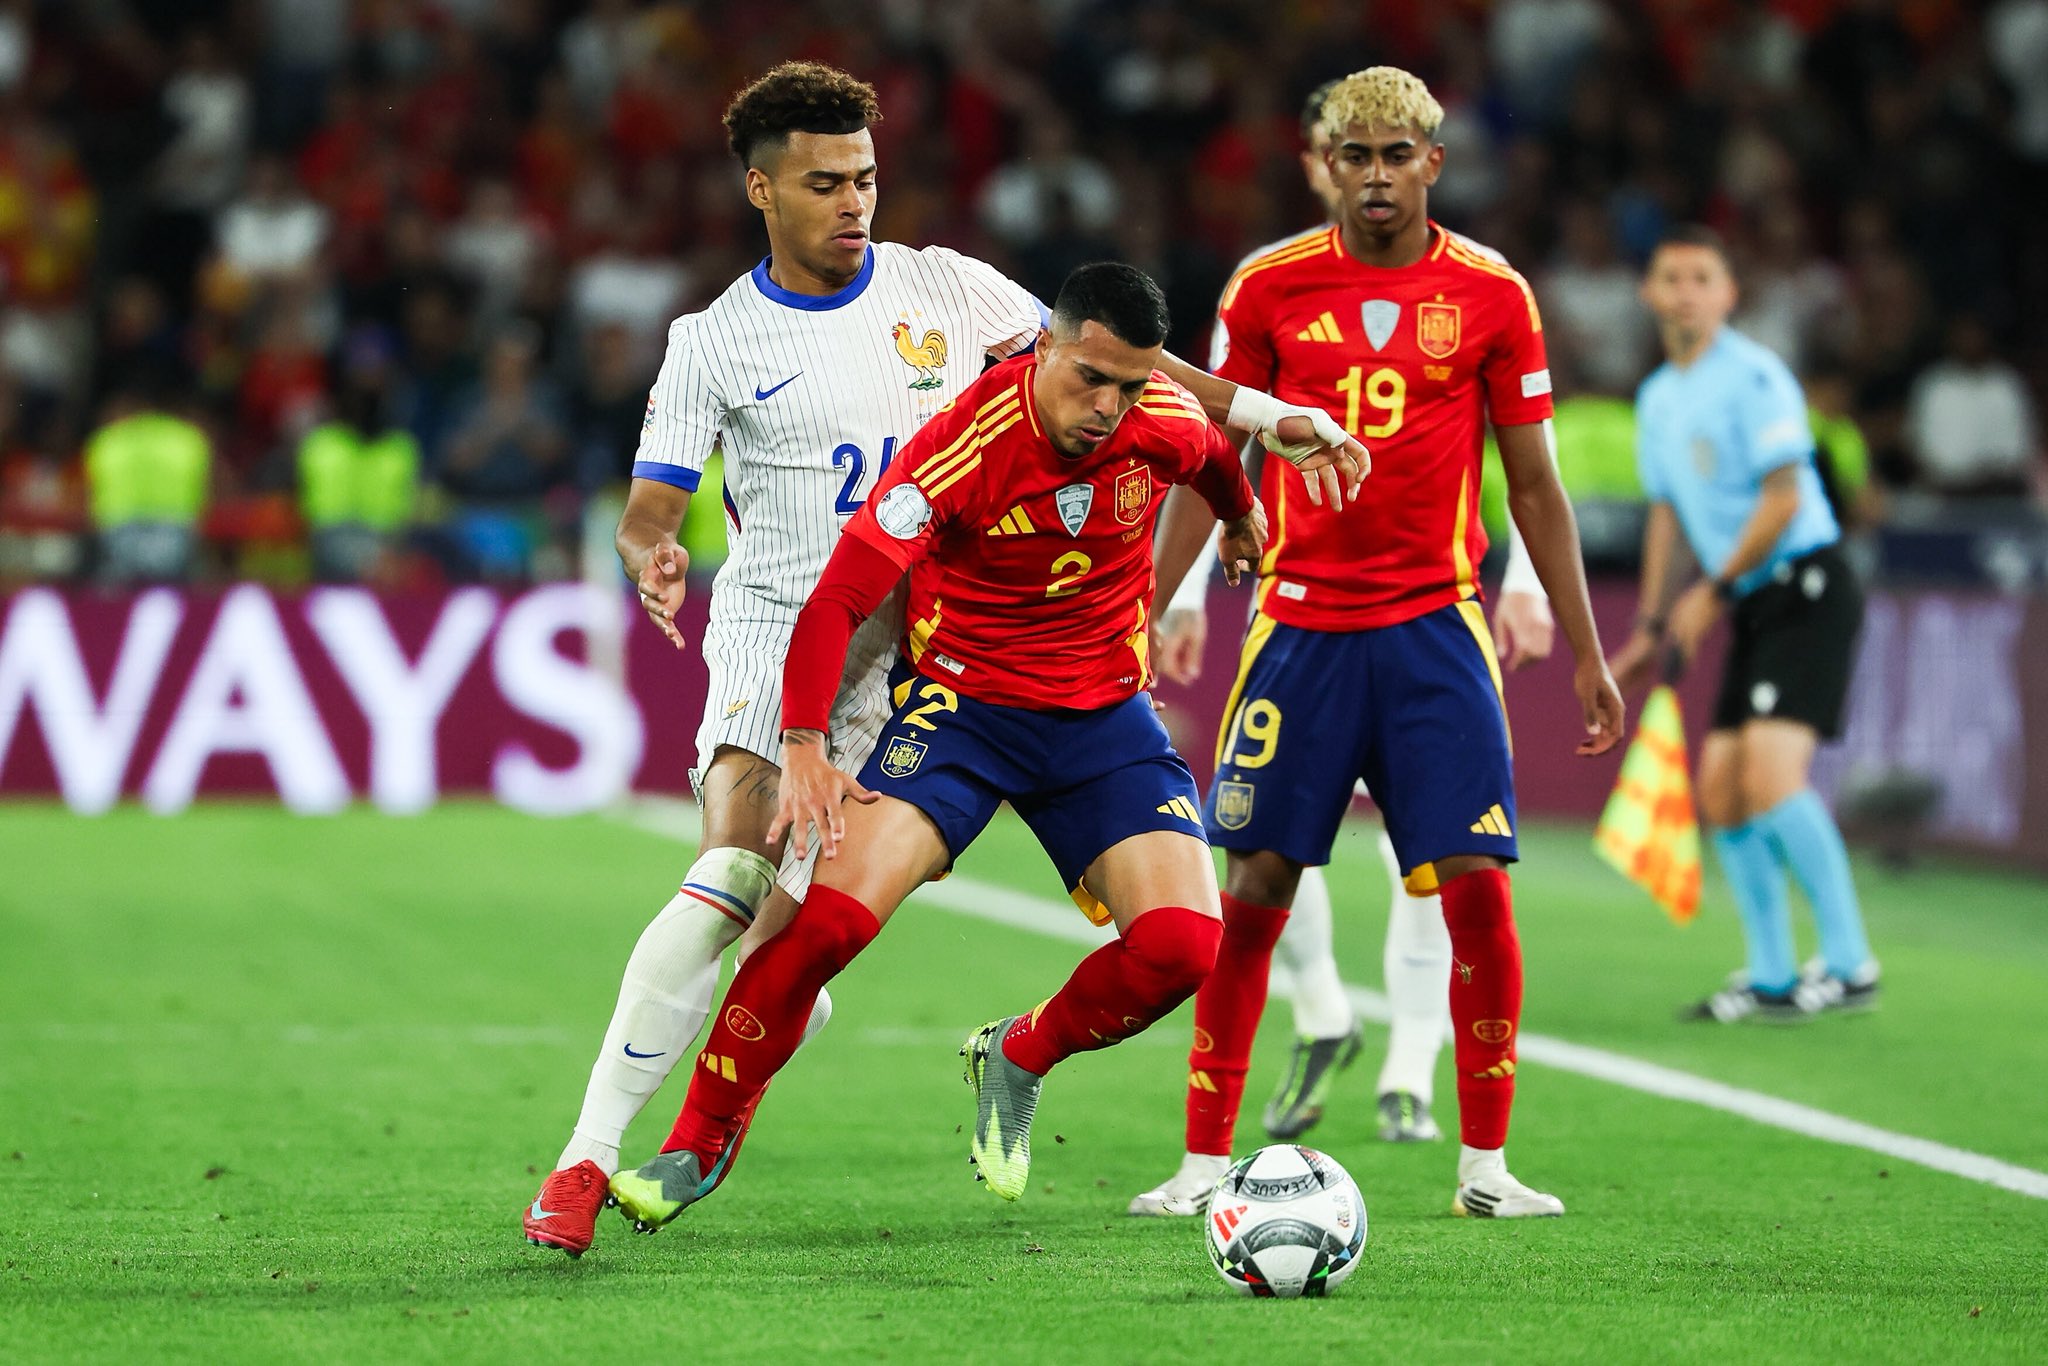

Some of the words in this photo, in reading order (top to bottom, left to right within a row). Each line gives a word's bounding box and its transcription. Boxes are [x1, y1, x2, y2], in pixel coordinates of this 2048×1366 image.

[1336, 366, 1407, 439] 19
[1045, 550, 1092, 598] 2
[0, 583, 646, 817] WAYS
[902, 683, 958, 731] 2
[1222, 697, 1282, 769] 19
[1250, 1177, 1309, 1197] LEAGUE
